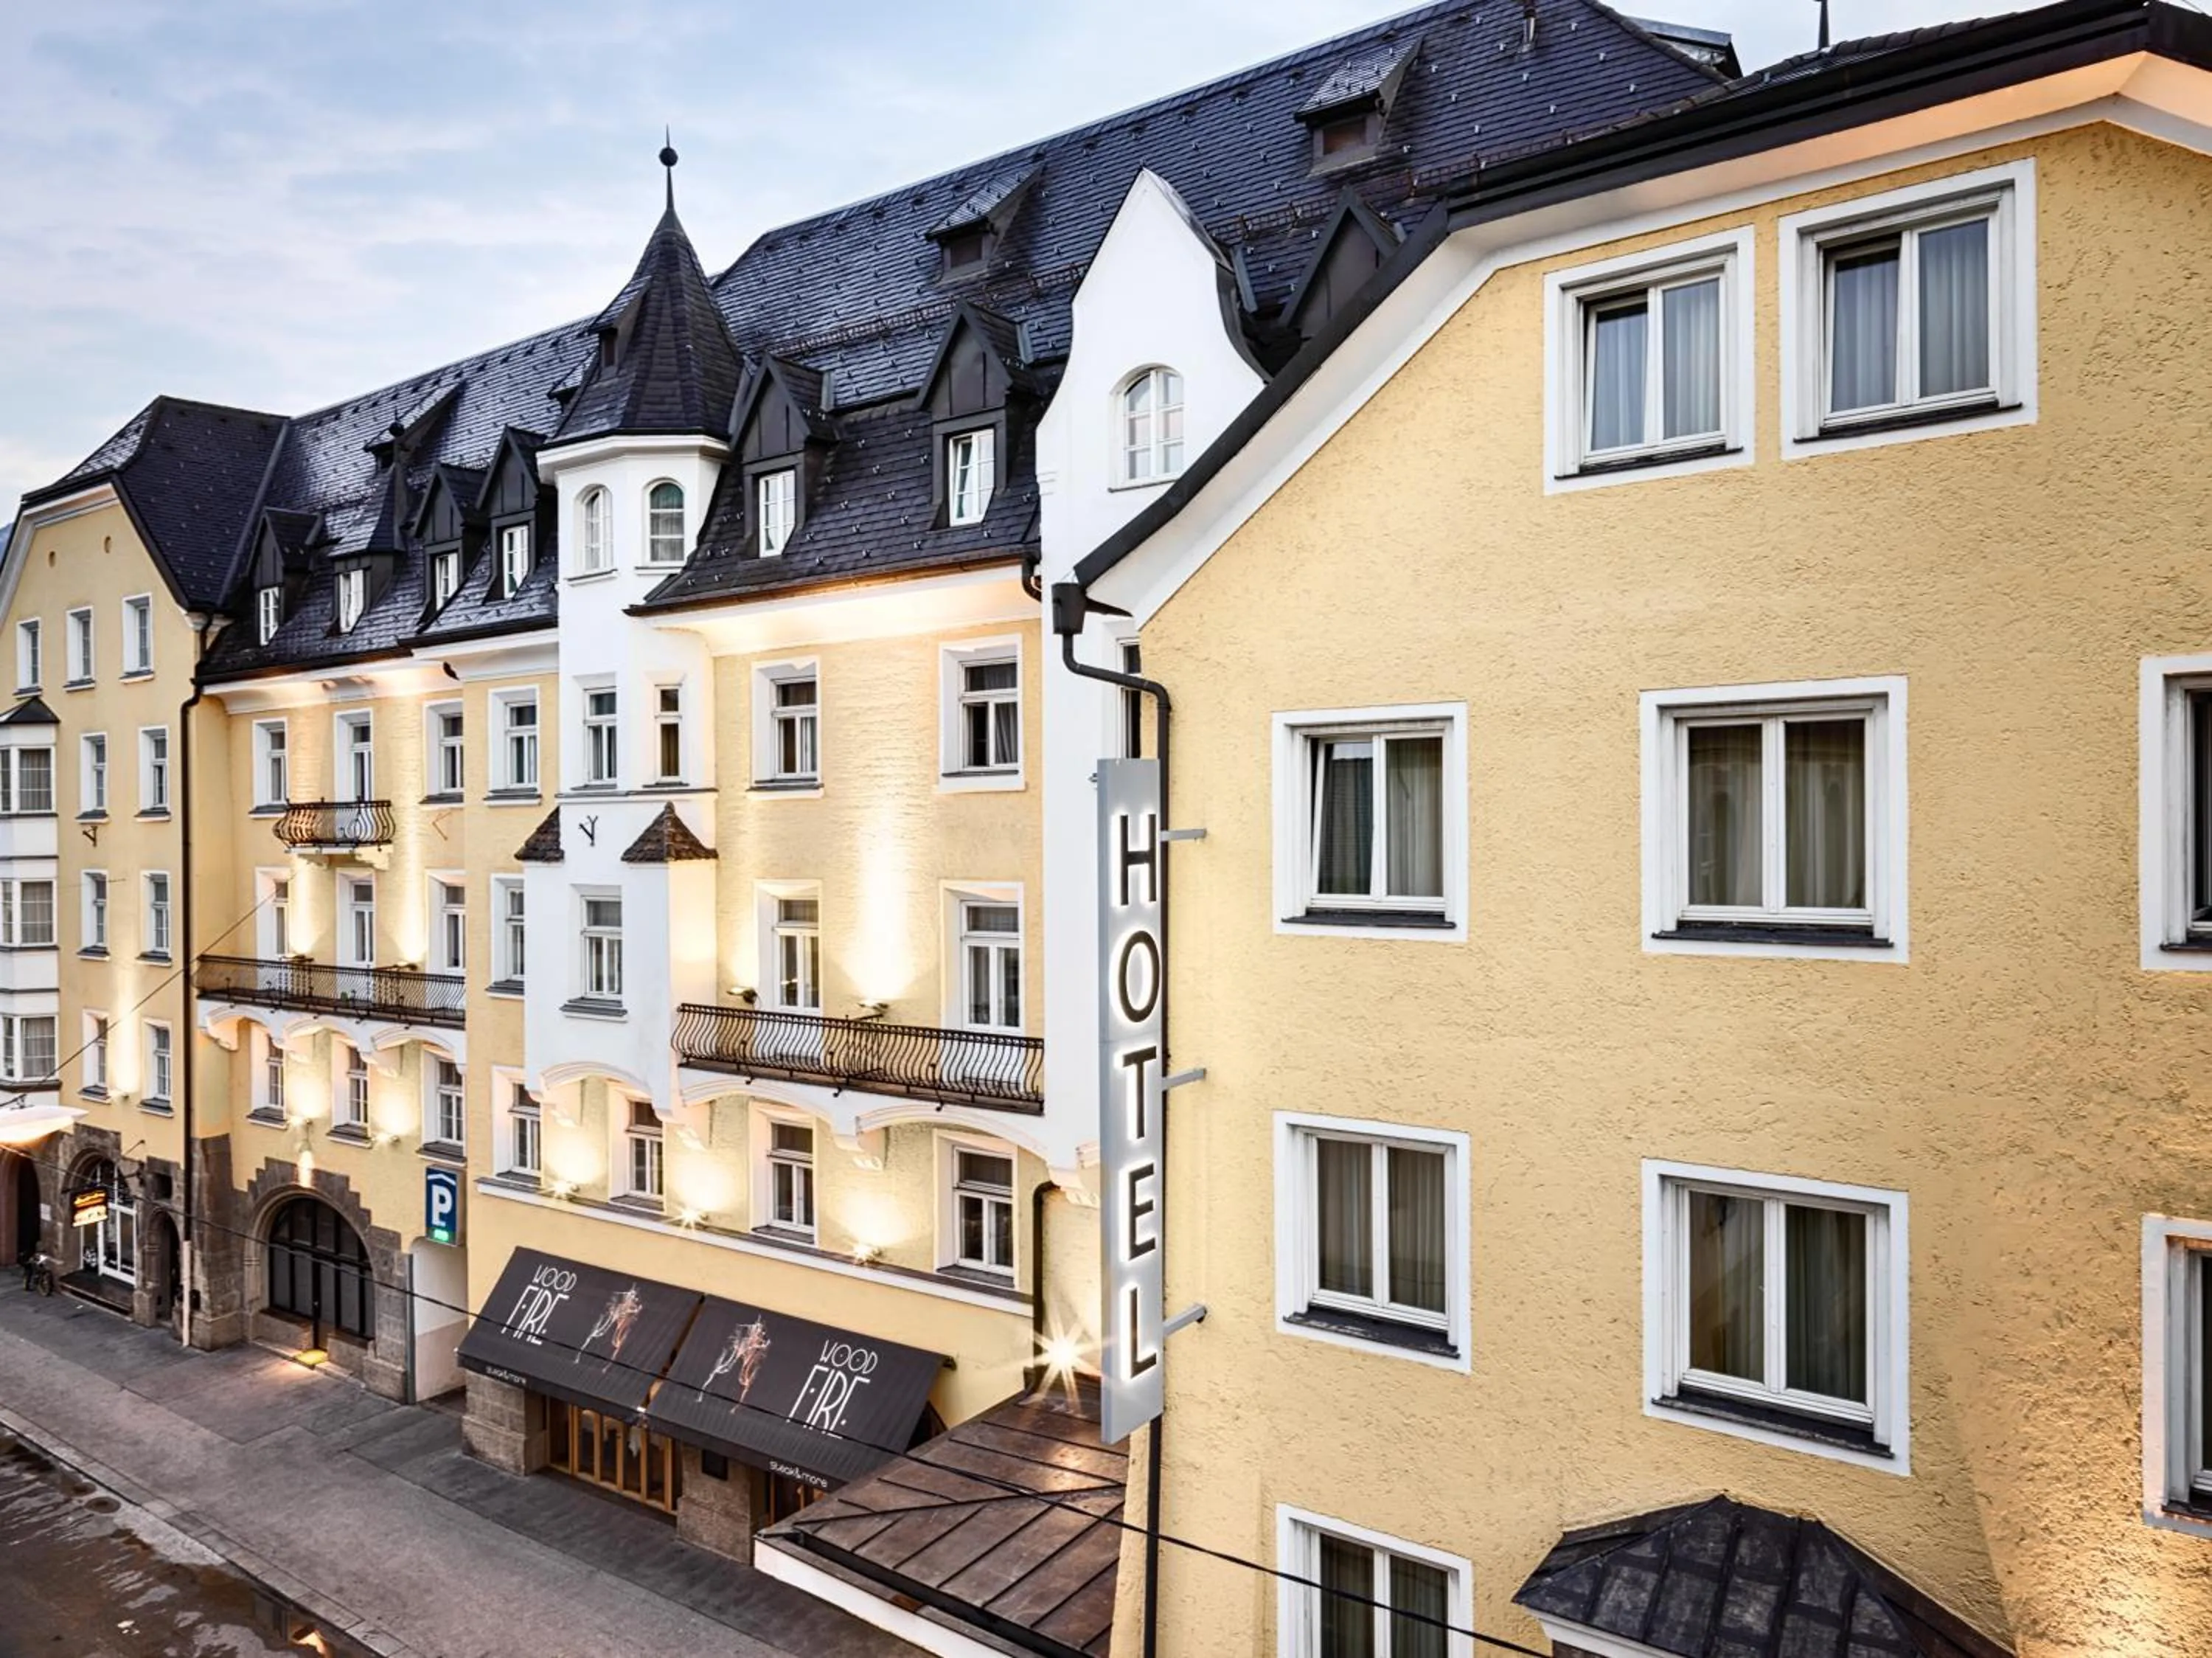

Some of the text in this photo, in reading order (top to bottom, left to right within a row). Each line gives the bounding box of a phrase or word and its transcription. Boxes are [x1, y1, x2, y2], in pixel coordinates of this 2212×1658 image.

[1116, 813, 1161, 1380] HOTEL
[432, 1184, 452, 1227] P
[532, 1264, 577, 1291] WOOD
[820, 1339, 877, 1373] WOOD
